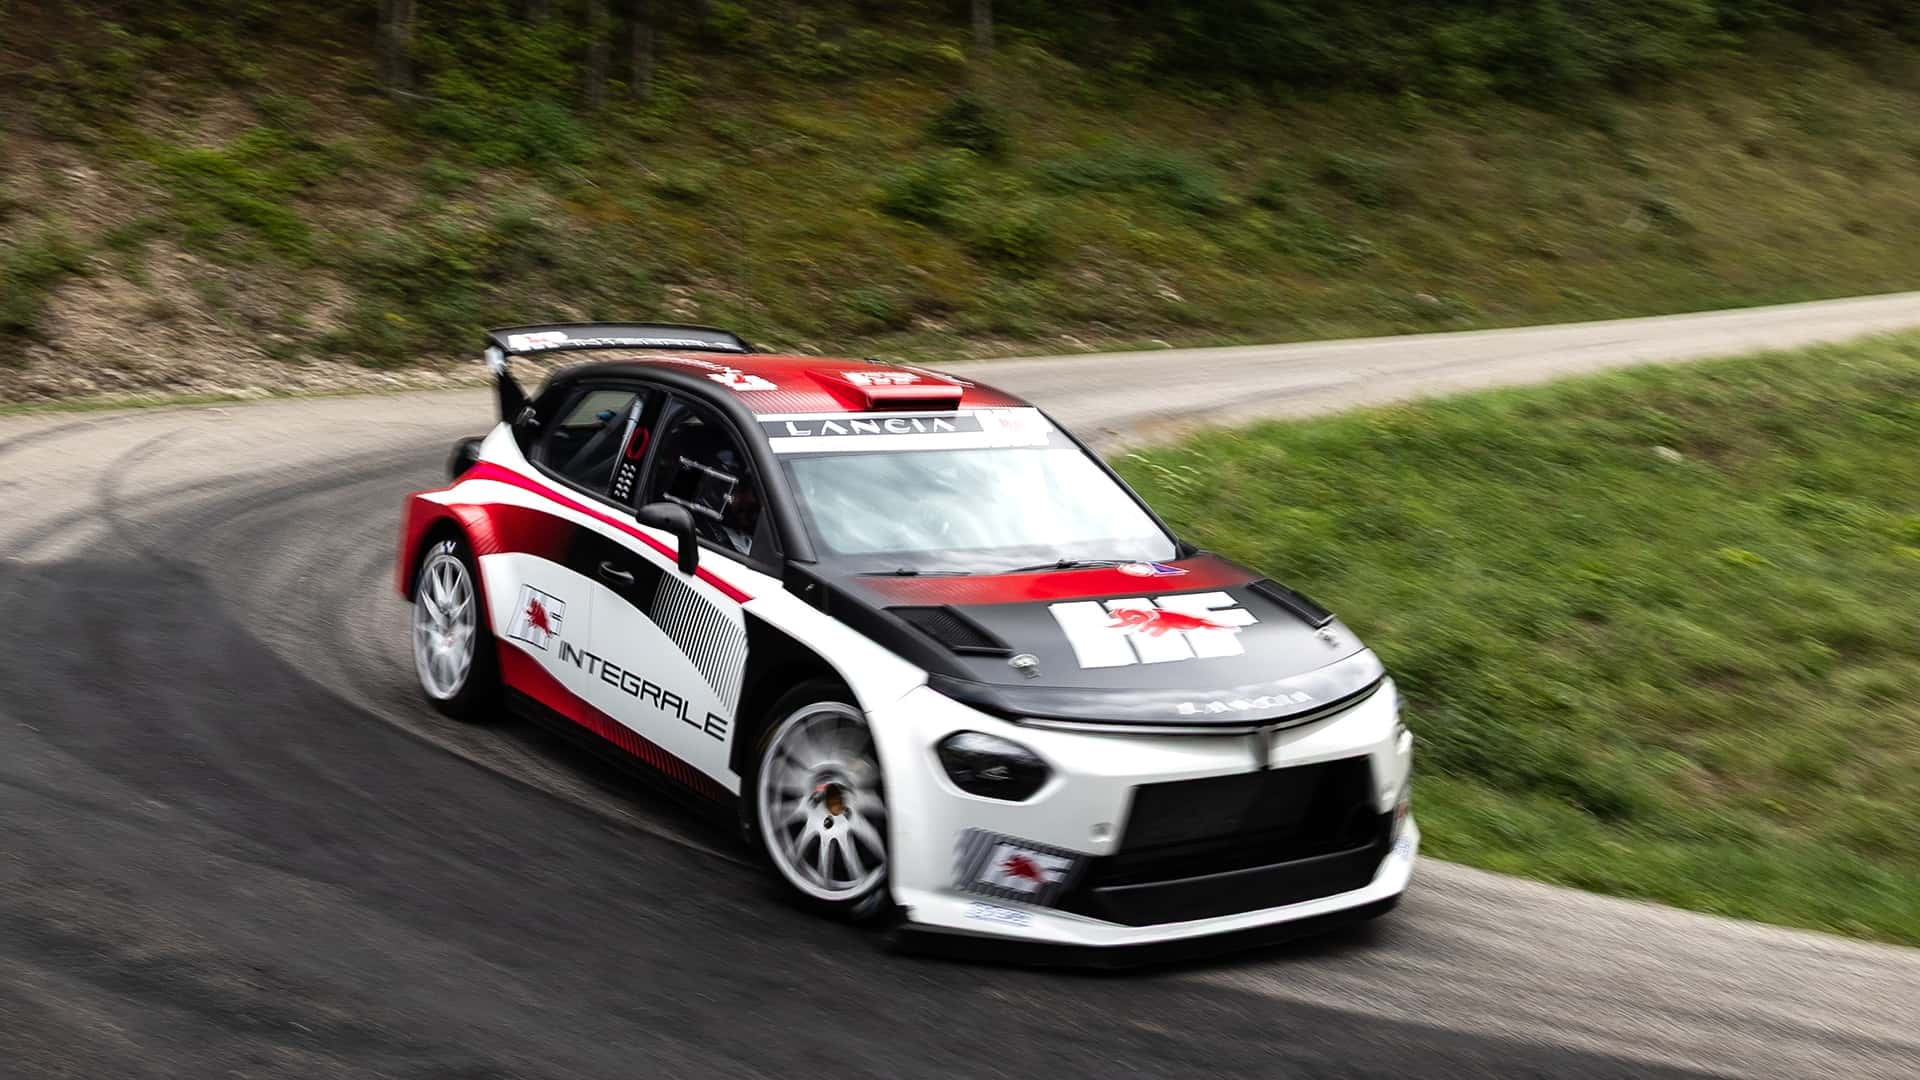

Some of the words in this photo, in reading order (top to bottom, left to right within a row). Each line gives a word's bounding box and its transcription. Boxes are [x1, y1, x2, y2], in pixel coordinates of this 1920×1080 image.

[785, 418, 957, 436] LANCIA
[1047, 591, 1260, 669] HF
[558, 640, 729, 742] INTEGRALE
